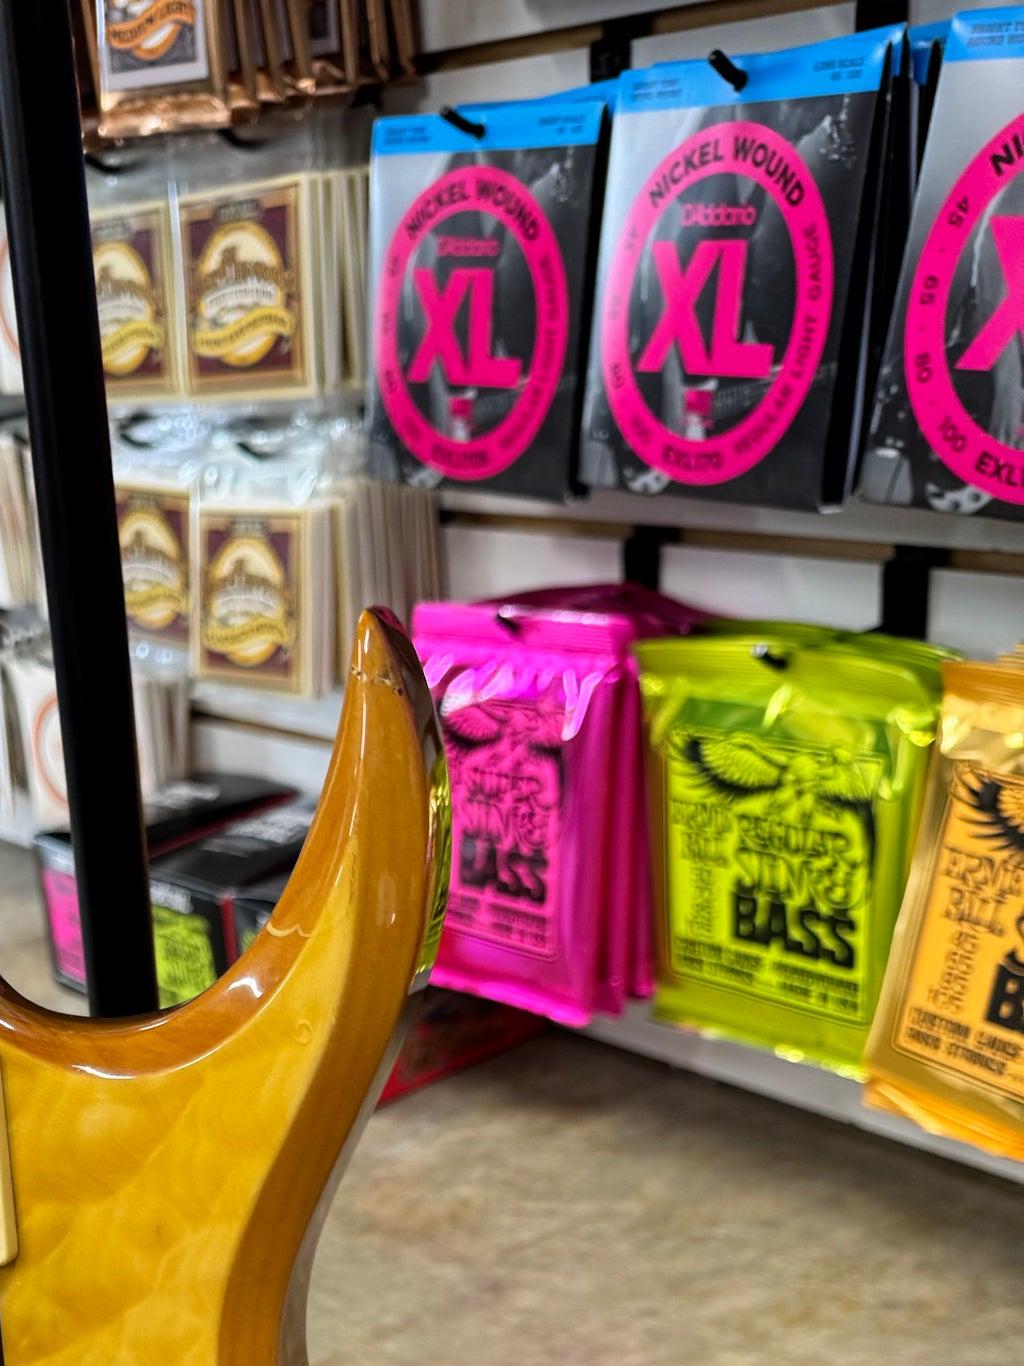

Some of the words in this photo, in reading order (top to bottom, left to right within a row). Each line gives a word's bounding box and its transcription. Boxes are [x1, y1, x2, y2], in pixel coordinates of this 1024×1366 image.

[648, 138, 724, 208] NICKEL
[734, 137, 805, 206] WOUND
[406, 180, 470, 240] NICKEL
[477, 180, 540, 241] WOUND
[947, 196, 970, 229] 45
[803, 222, 823, 301] GAUGE
[920, 276, 939, 305] 65
[406, 268, 522, 388] XL
[636, 240, 774, 378] XL
[790, 315, 818, 379] LIGHT
[914, 352, 933, 384] 80
[939, 415, 968, 453] 100
[460, 829, 549, 905] BASS
[736, 814, 862, 870] REGULAR
[734, 878, 858, 972] BASS
